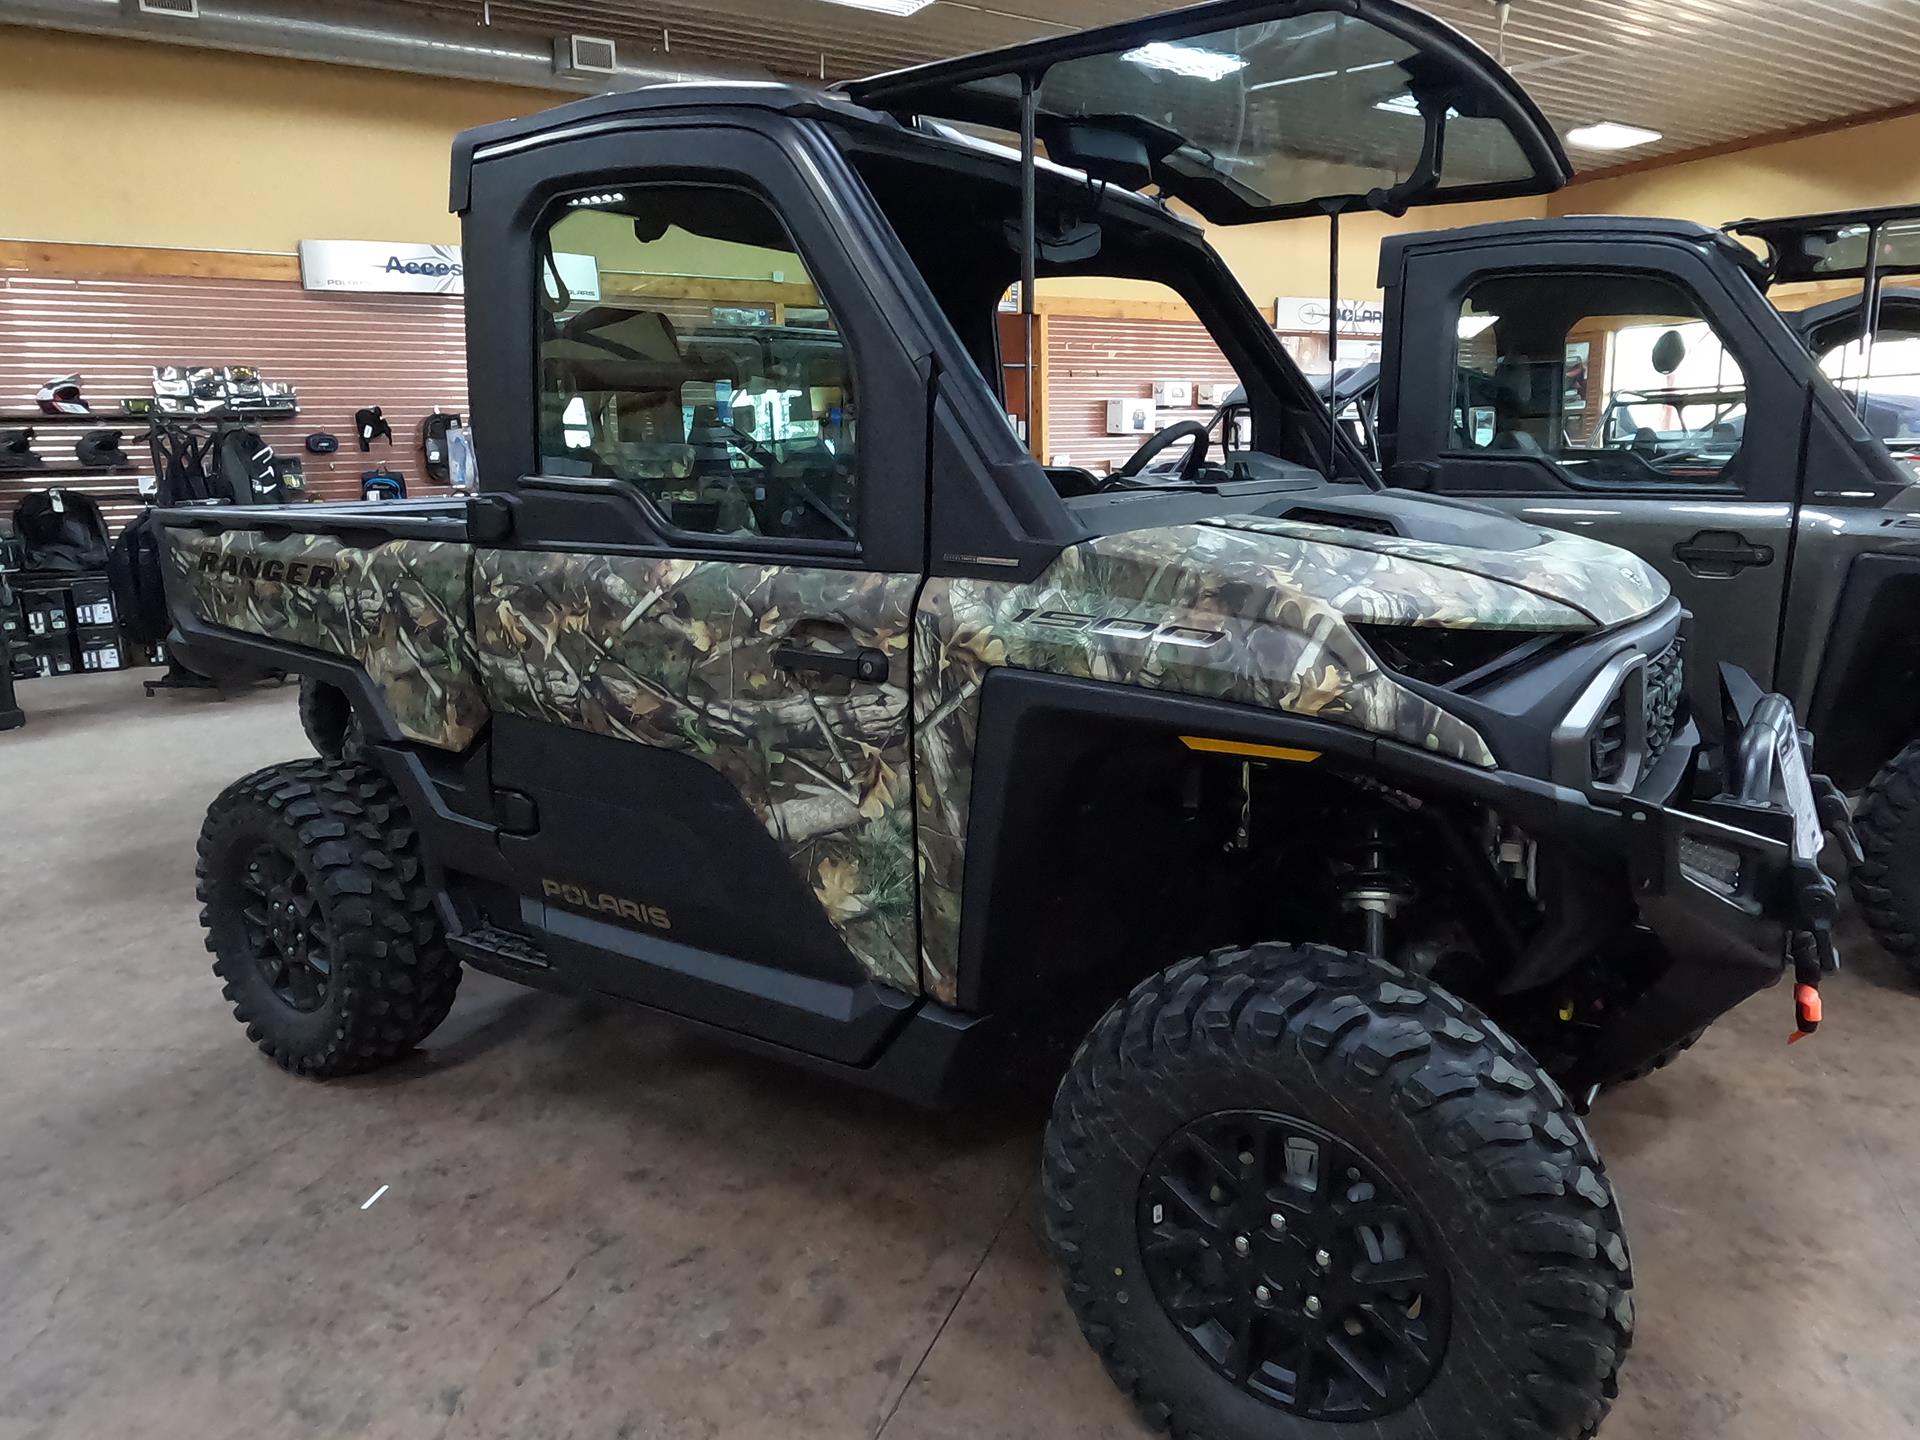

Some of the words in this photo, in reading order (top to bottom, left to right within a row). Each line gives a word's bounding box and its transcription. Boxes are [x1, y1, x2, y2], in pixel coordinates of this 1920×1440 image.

[568, 289, 595, 297] OLARIS
[198, 551, 336, 589] RANGER
[1012, 607, 1229, 649] 1500
[542, 878, 673, 930] POLARIS
